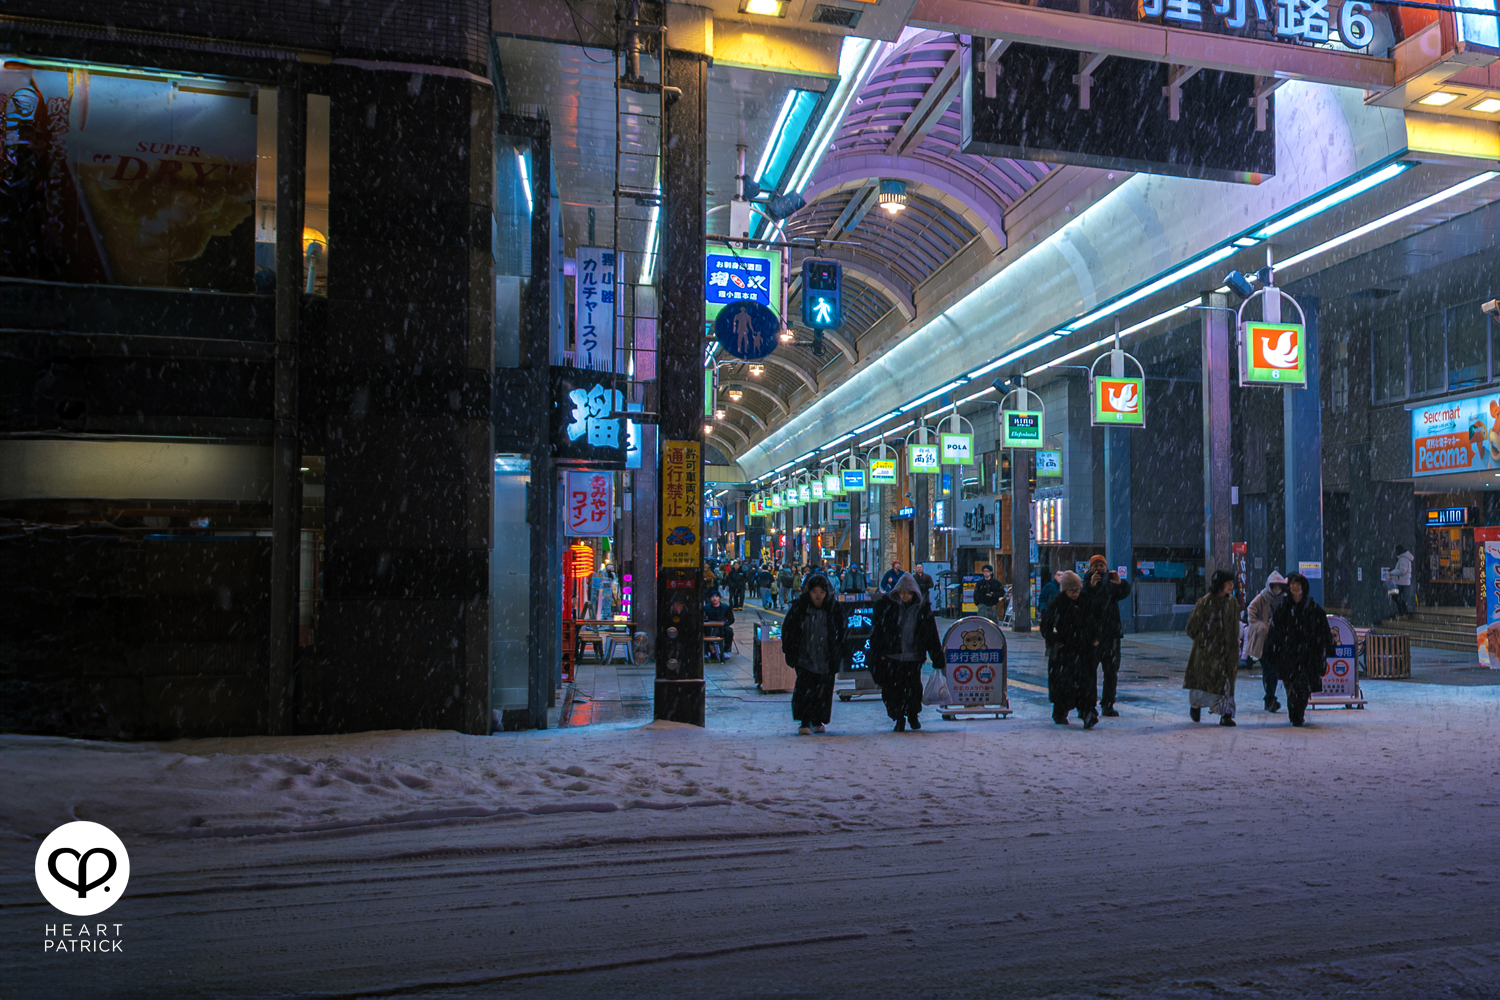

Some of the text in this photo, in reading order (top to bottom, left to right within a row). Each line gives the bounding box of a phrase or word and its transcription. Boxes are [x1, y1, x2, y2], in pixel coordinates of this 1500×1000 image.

[136, 141, 201, 157] SUPER
[582, 258, 598, 370] カルチャースクー
[1272, 369, 1280, 379] 6
[1116, 412, 1123, 421] 6
[1419, 446, 1468, 470] Pecoma
[667, 448, 683, 517] 通行禁止
[572, 491, 588, 527] ワイン
[949, 652, 999, 663] 歩行者専用
